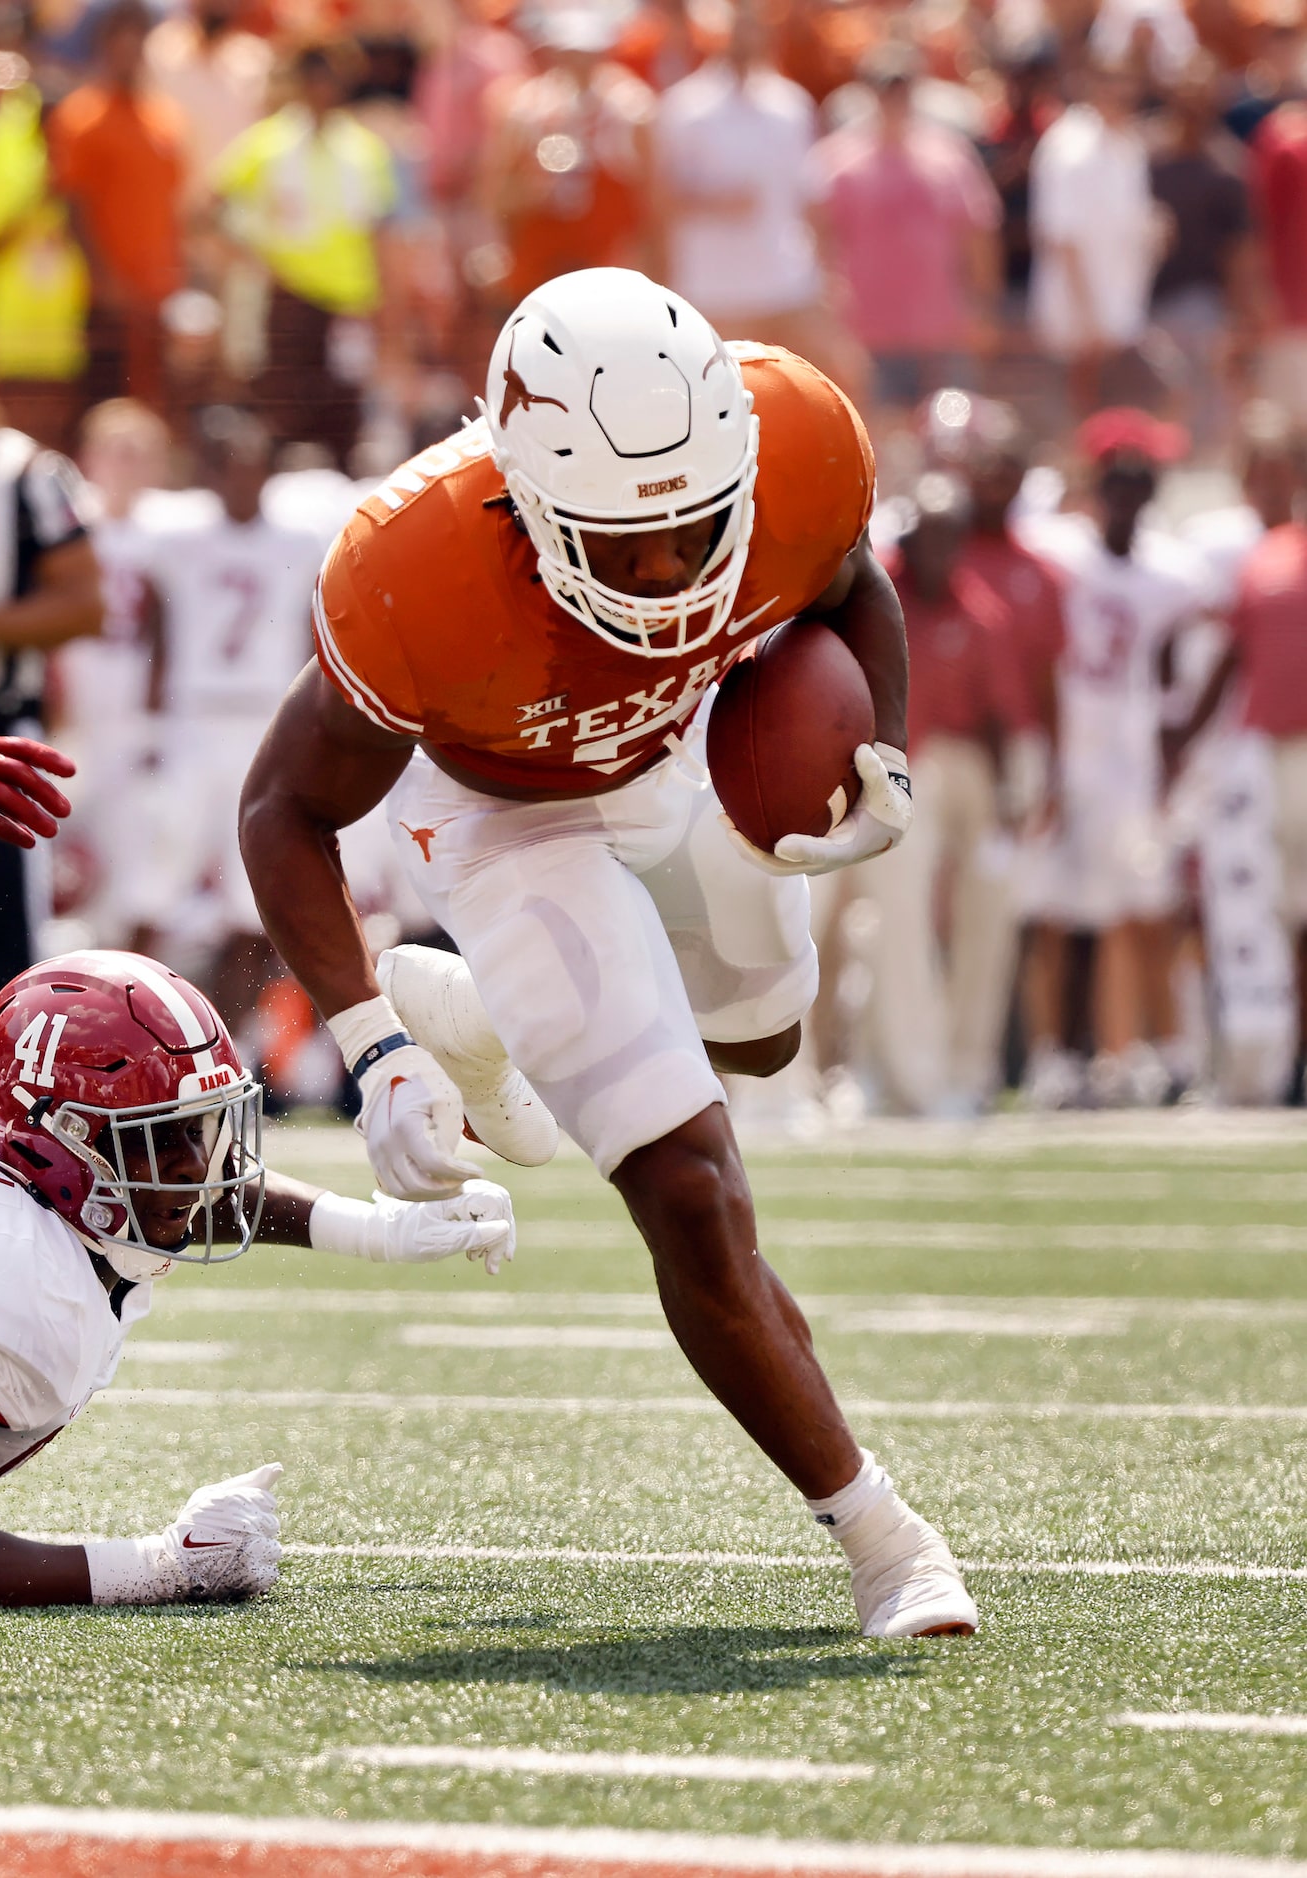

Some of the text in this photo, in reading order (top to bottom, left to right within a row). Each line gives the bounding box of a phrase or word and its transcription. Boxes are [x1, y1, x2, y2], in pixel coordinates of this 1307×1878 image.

[637, 475, 687, 498] HORNS
[516, 694, 567, 723] XII
[15, 1010, 69, 1089] 41
[198, 1071, 231, 1092] BAMA
